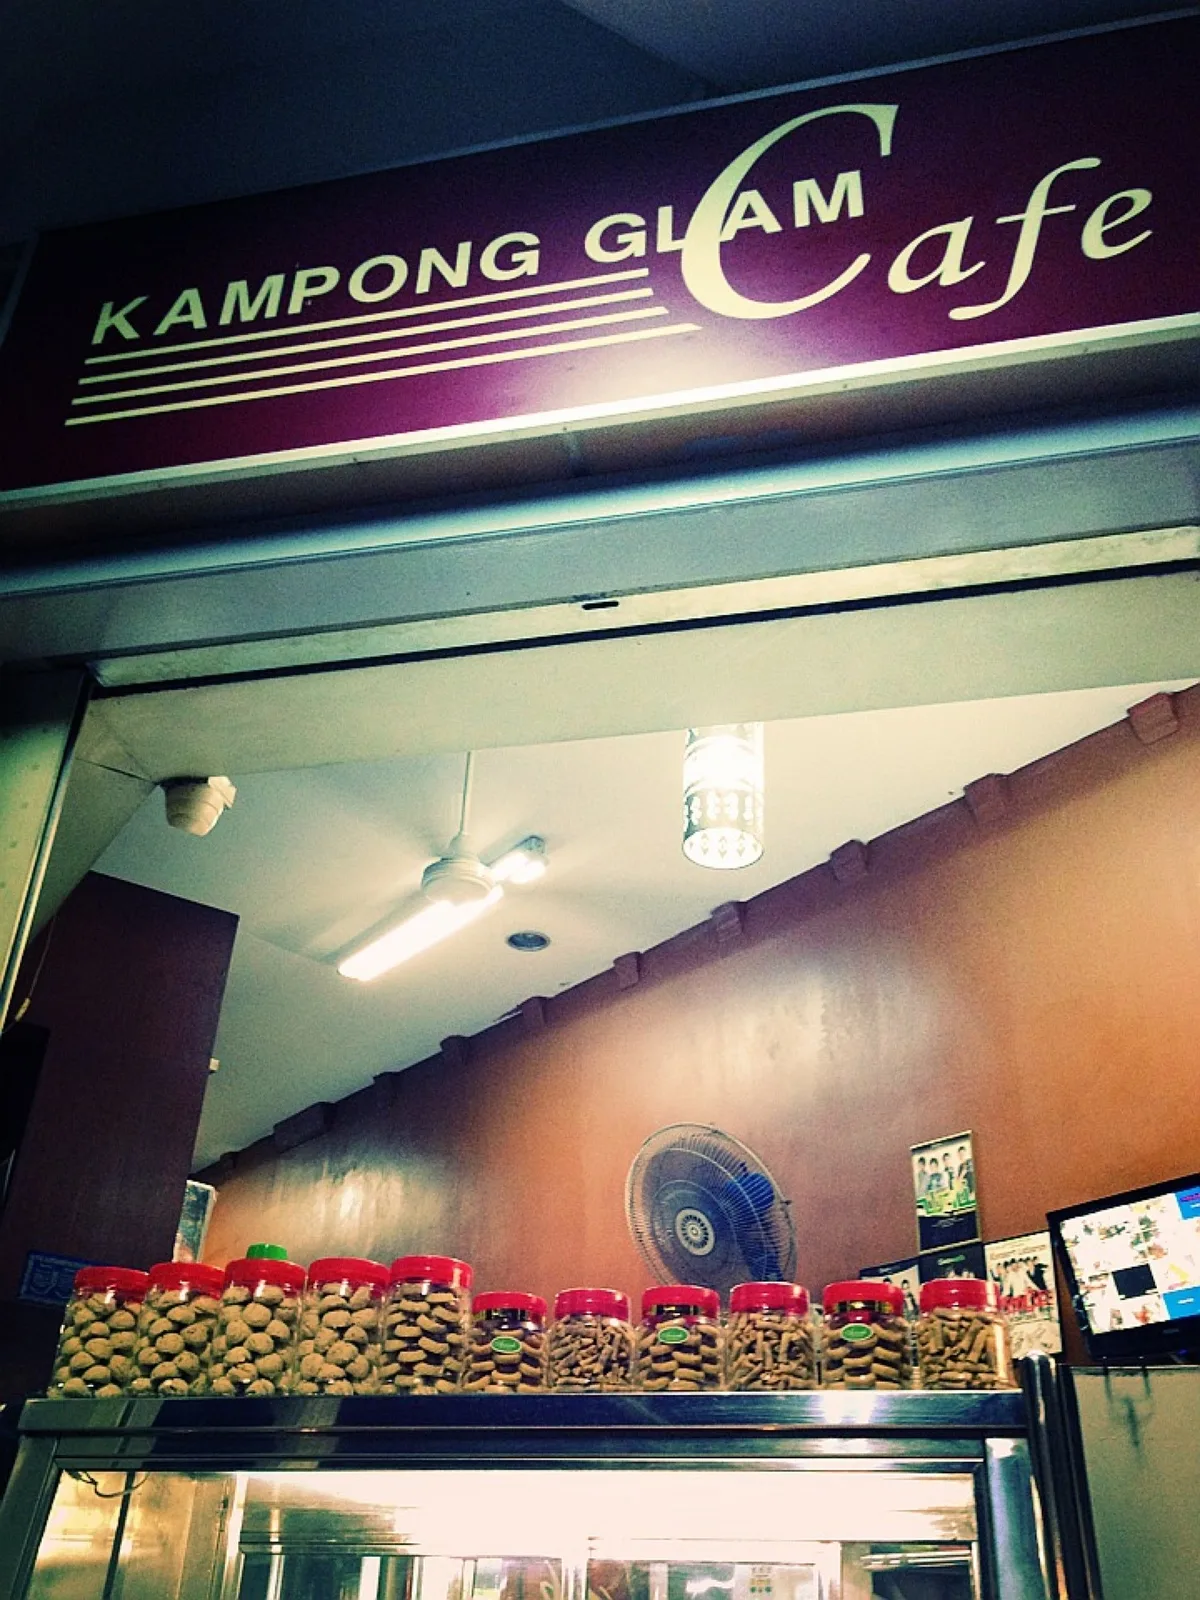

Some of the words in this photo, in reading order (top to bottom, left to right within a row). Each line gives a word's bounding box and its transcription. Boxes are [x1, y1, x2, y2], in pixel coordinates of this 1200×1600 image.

[92, 231, 541, 345] KAMPONG
[584, 169, 864, 264] GLAM
[680, 103, 1153, 321] Cafe
